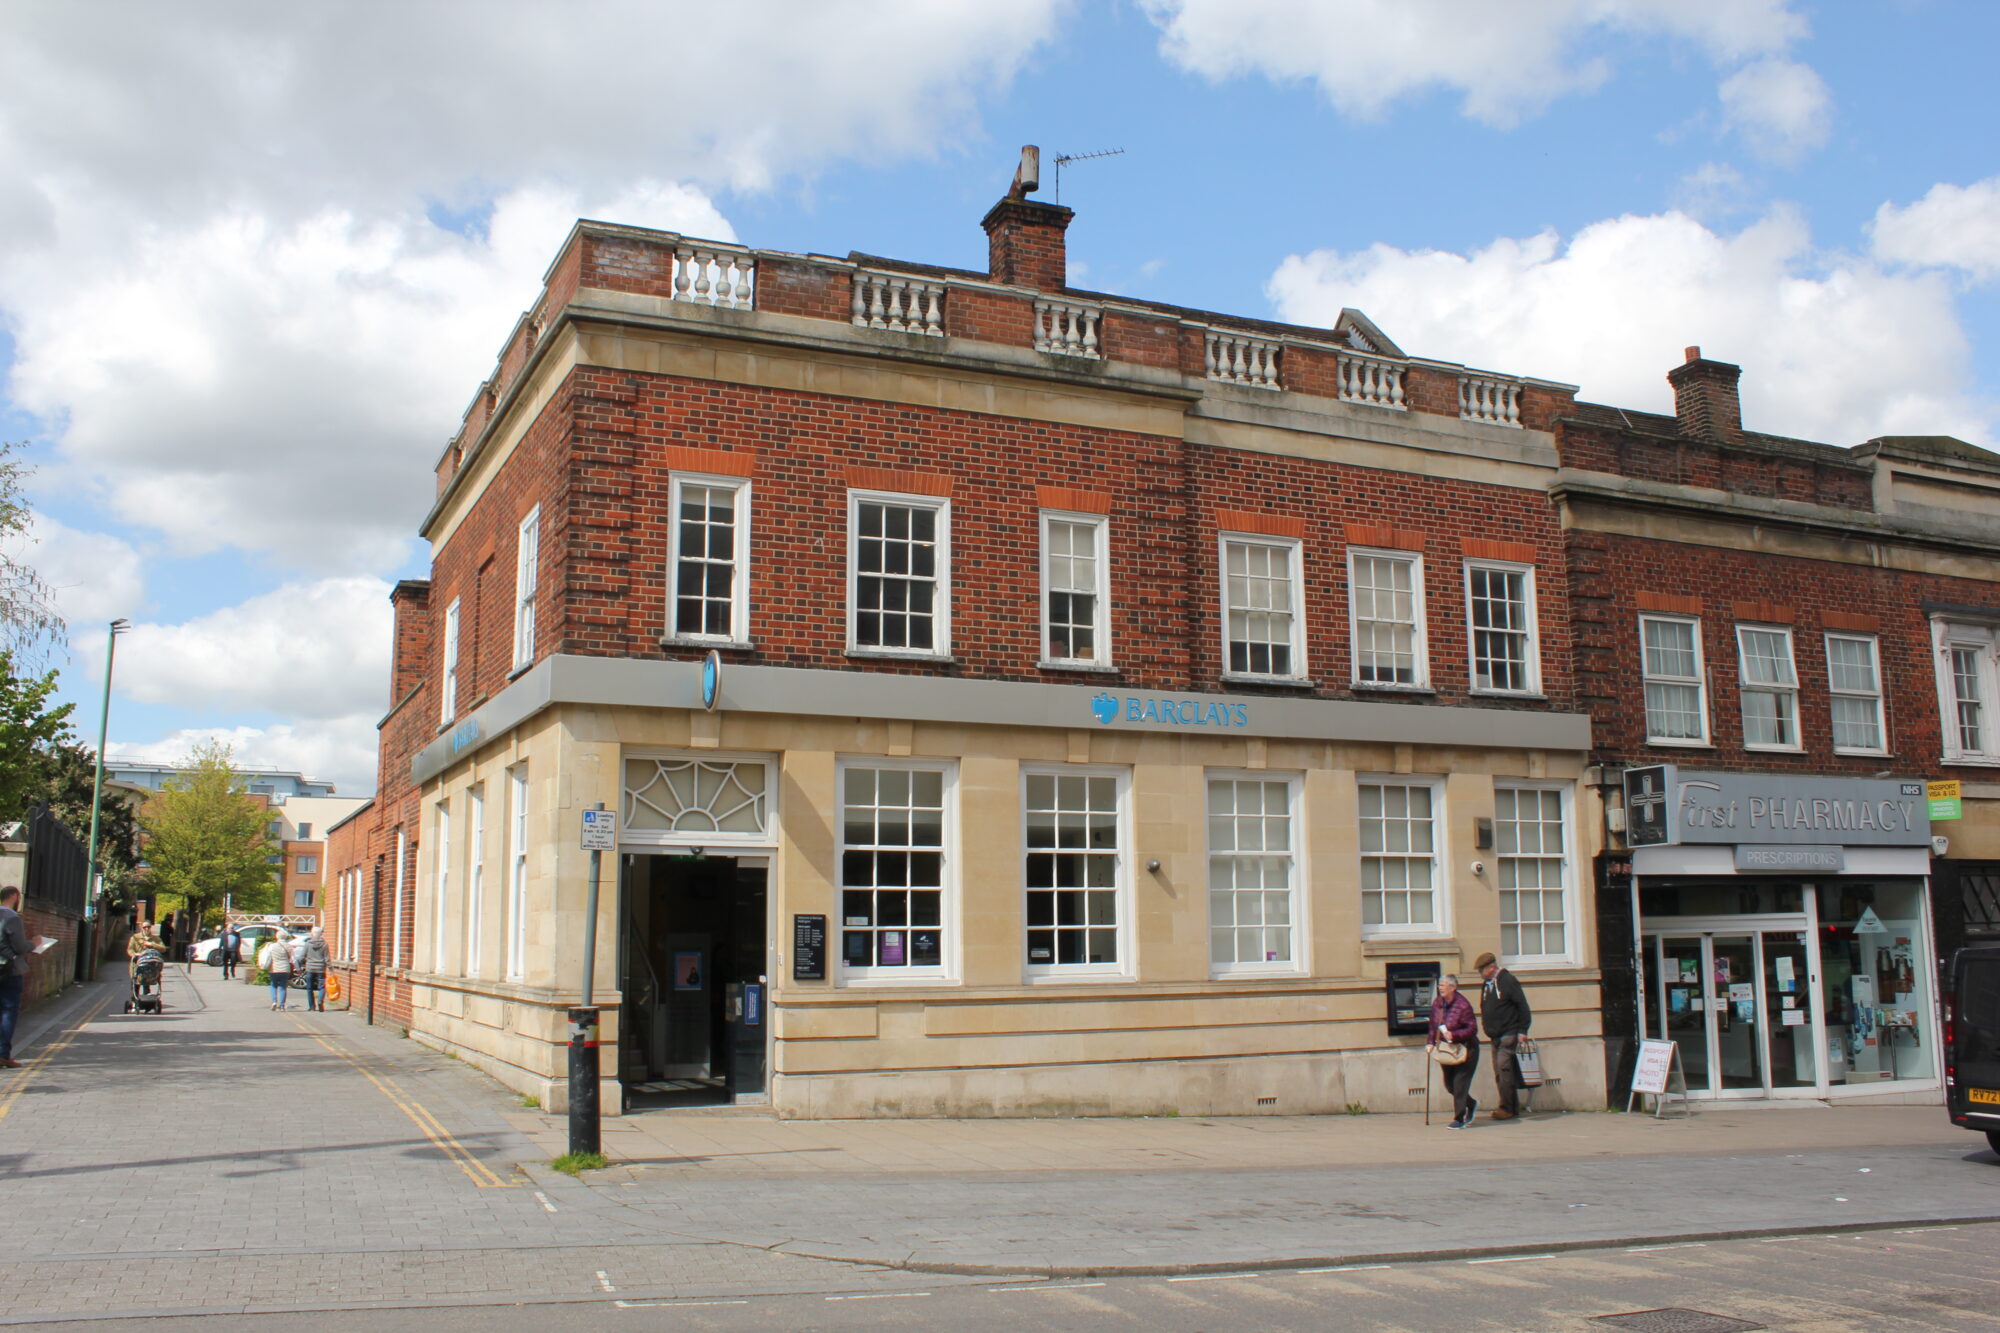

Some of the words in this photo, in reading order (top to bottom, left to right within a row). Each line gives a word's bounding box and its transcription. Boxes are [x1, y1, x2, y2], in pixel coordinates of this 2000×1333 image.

[1126, 697, 1248, 727] BARCLAYS
[1902, 785, 1920, 795] NHS
[1678, 779, 1738, 828] First
[1748, 796, 1914, 832] PHARMACY
[1747, 851, 1838, 865] PRESCRIPTIONS
